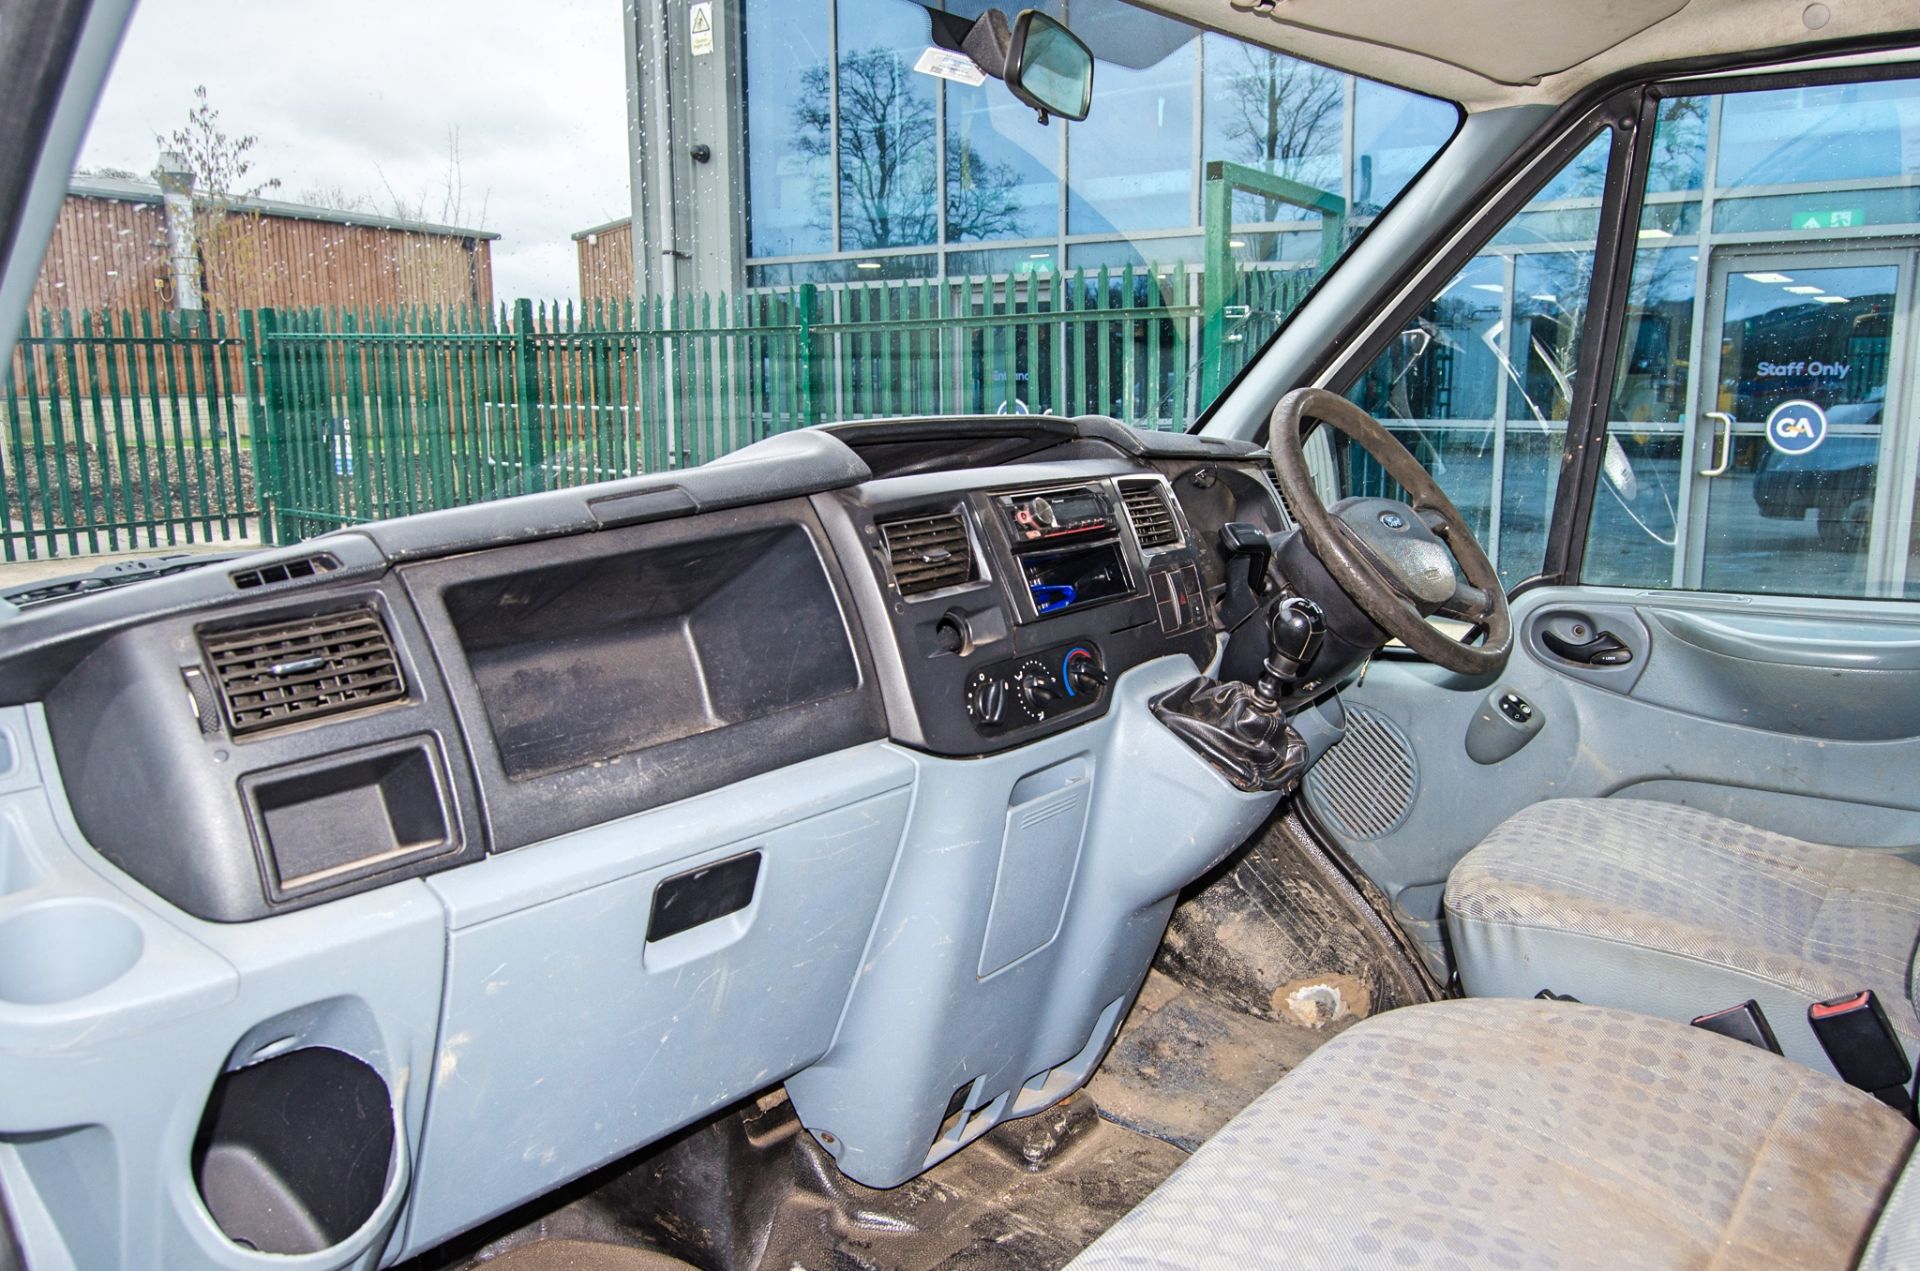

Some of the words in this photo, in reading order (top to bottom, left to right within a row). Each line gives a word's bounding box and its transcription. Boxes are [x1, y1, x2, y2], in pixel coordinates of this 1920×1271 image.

[1757, 362, 1805, 376] Staff
[1807, 361, 1850, 379] Only
[1776, 417, 1815, 438] GA
